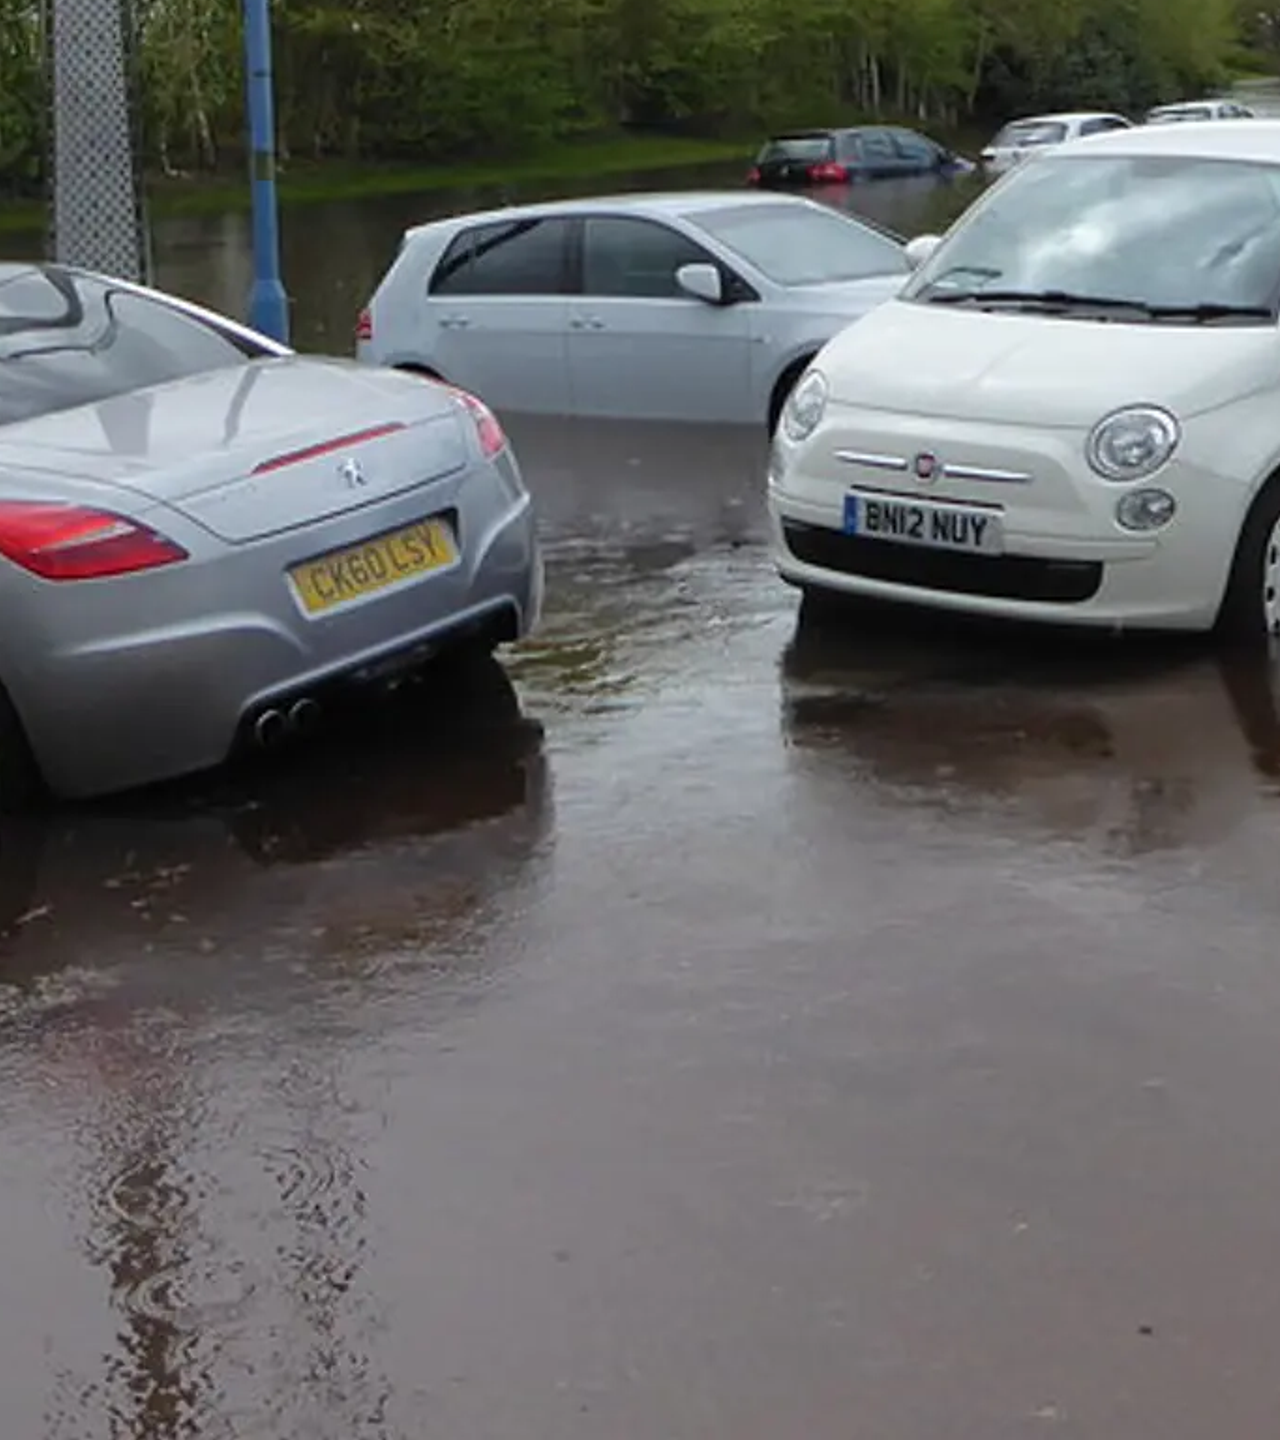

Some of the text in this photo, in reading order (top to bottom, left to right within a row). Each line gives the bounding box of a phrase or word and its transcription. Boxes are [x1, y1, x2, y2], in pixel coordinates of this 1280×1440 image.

[865, 501, 987, 546] BN12 NUY
[309, 523, 439, 601] CK60 LSY
